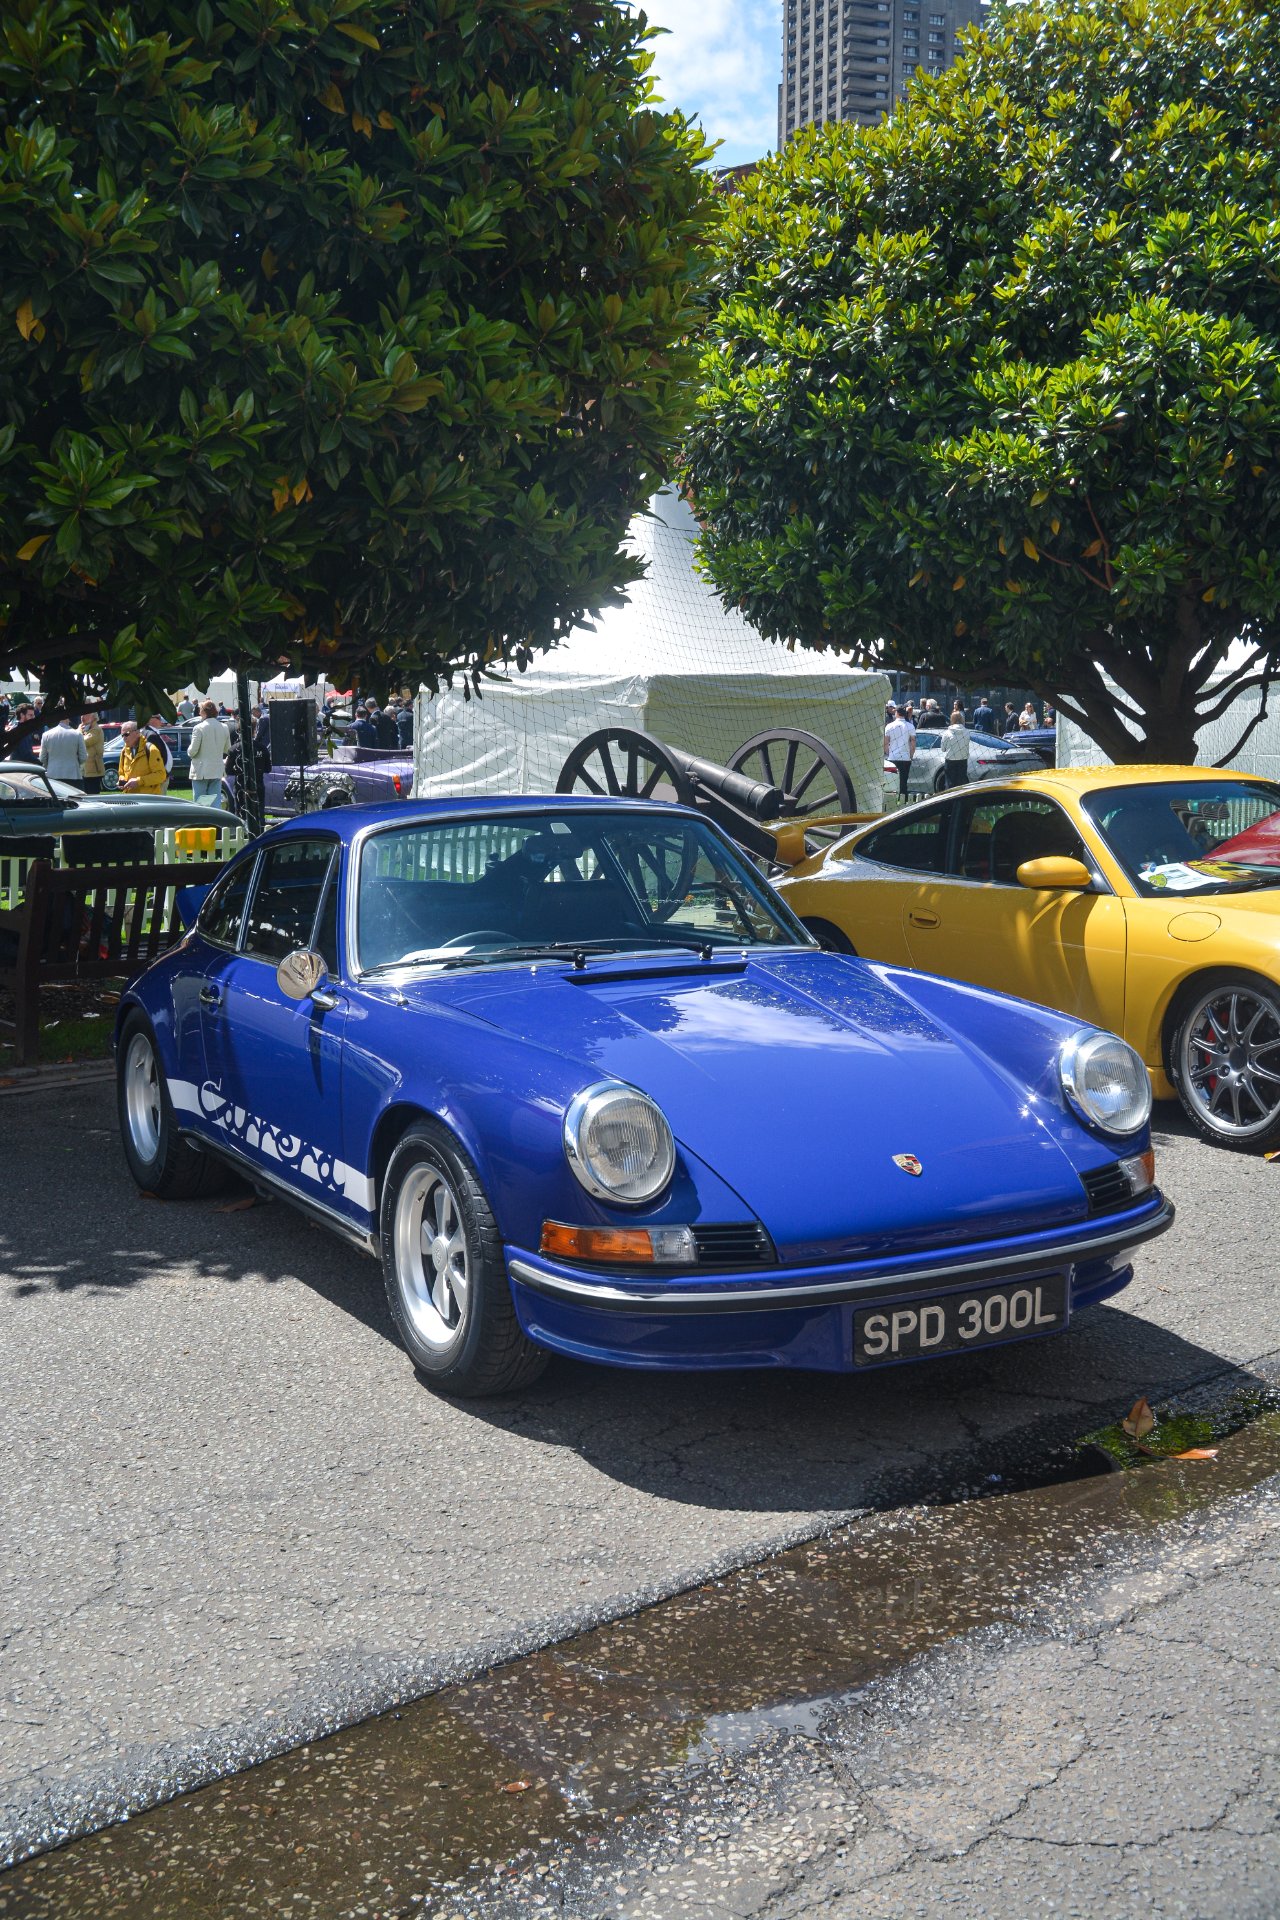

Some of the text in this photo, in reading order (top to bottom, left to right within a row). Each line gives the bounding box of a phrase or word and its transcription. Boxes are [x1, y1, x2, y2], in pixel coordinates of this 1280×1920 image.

[198, 1077, 346, 1198] Carrera
[863, 1286, 1057, 1356] SPD 300L
